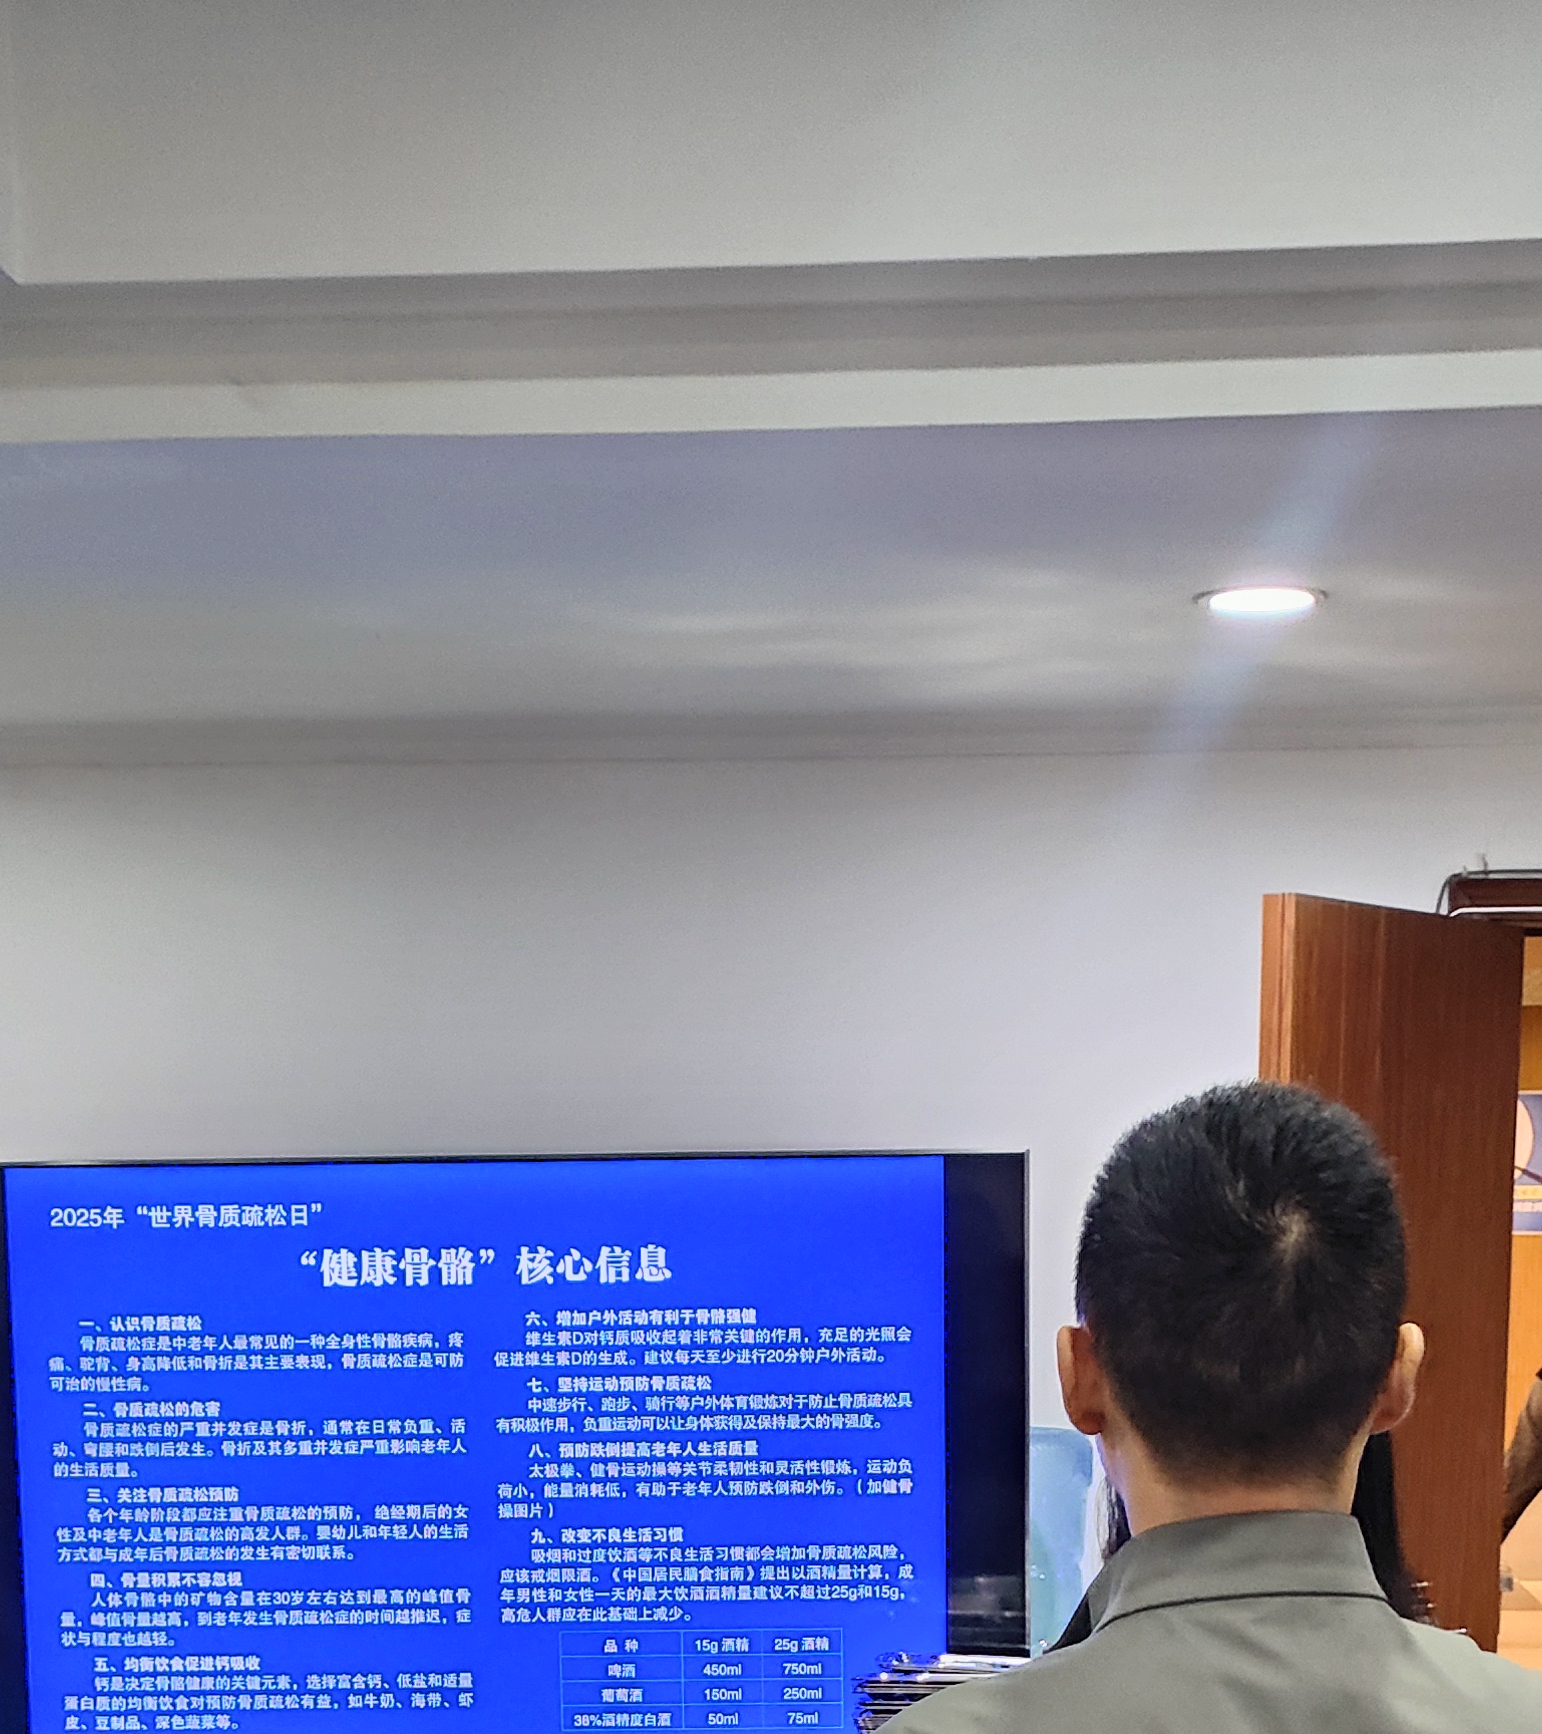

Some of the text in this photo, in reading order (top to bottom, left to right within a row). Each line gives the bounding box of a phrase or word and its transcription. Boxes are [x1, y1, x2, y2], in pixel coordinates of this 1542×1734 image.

[79, 1316, 201, 1331] 一、认识骨质疏松
[526, 1308, 756, 1326] 六、增加户外活动有利于骨骼强健
[49, 1376, 148, 1392] 可治的慢性病。
[527, 1375, 711, 1392] 七、坚持运动预防骨质疏松
[84, 1401, 220, 1417] 二、骨质疏松的危害
[529, 1441, 758, 1458] 八、预防跌倒提高老年人生活质量
[54, 1462, 137, 1477] 的生活质量。
[87, 1487, 238, 1503] 三、关注骨质疏松预防
[531, 1527, 683, 1543] 九、改变不良生活习惯
[58, 1545, 353, 1562] 方式都与成年后骨质疏松的发生有密切联系。
[91, 1572, 242, 1588] 四、骨量积累不容忽视
[501, 1606, 690, 1623] 高危人群应在此基础上减少。
[61, 1631, 174, 1646] 状与程度也越轻。
[695, 1637, 749, 1654] 15g 酒精
[774, 1636, 829, 1653] 25g 酒精
[95, 1656, 260, 1672] 五、均衡饮食促进钙吸收
[608, 1664, 635, 1678] 啤酒
[704, 1664, 741, 1675] 450ml
[783, 1663, 821, 1674] 750ml
[602, 1688, 642, 1702] 葡萄酒
[705, 1688, 741, 1700] 150ml
[784, 1688, 822, 1699] 250ml
[65, 1714, 238, 1730] 皮、豆制品、深色蔬菜等。
[574, 1713, 671, 1726] 38%酒精度白酒
[709, 1713, 738, 1724] 50ml
[787, 1712, 819, 1725] 75ml
